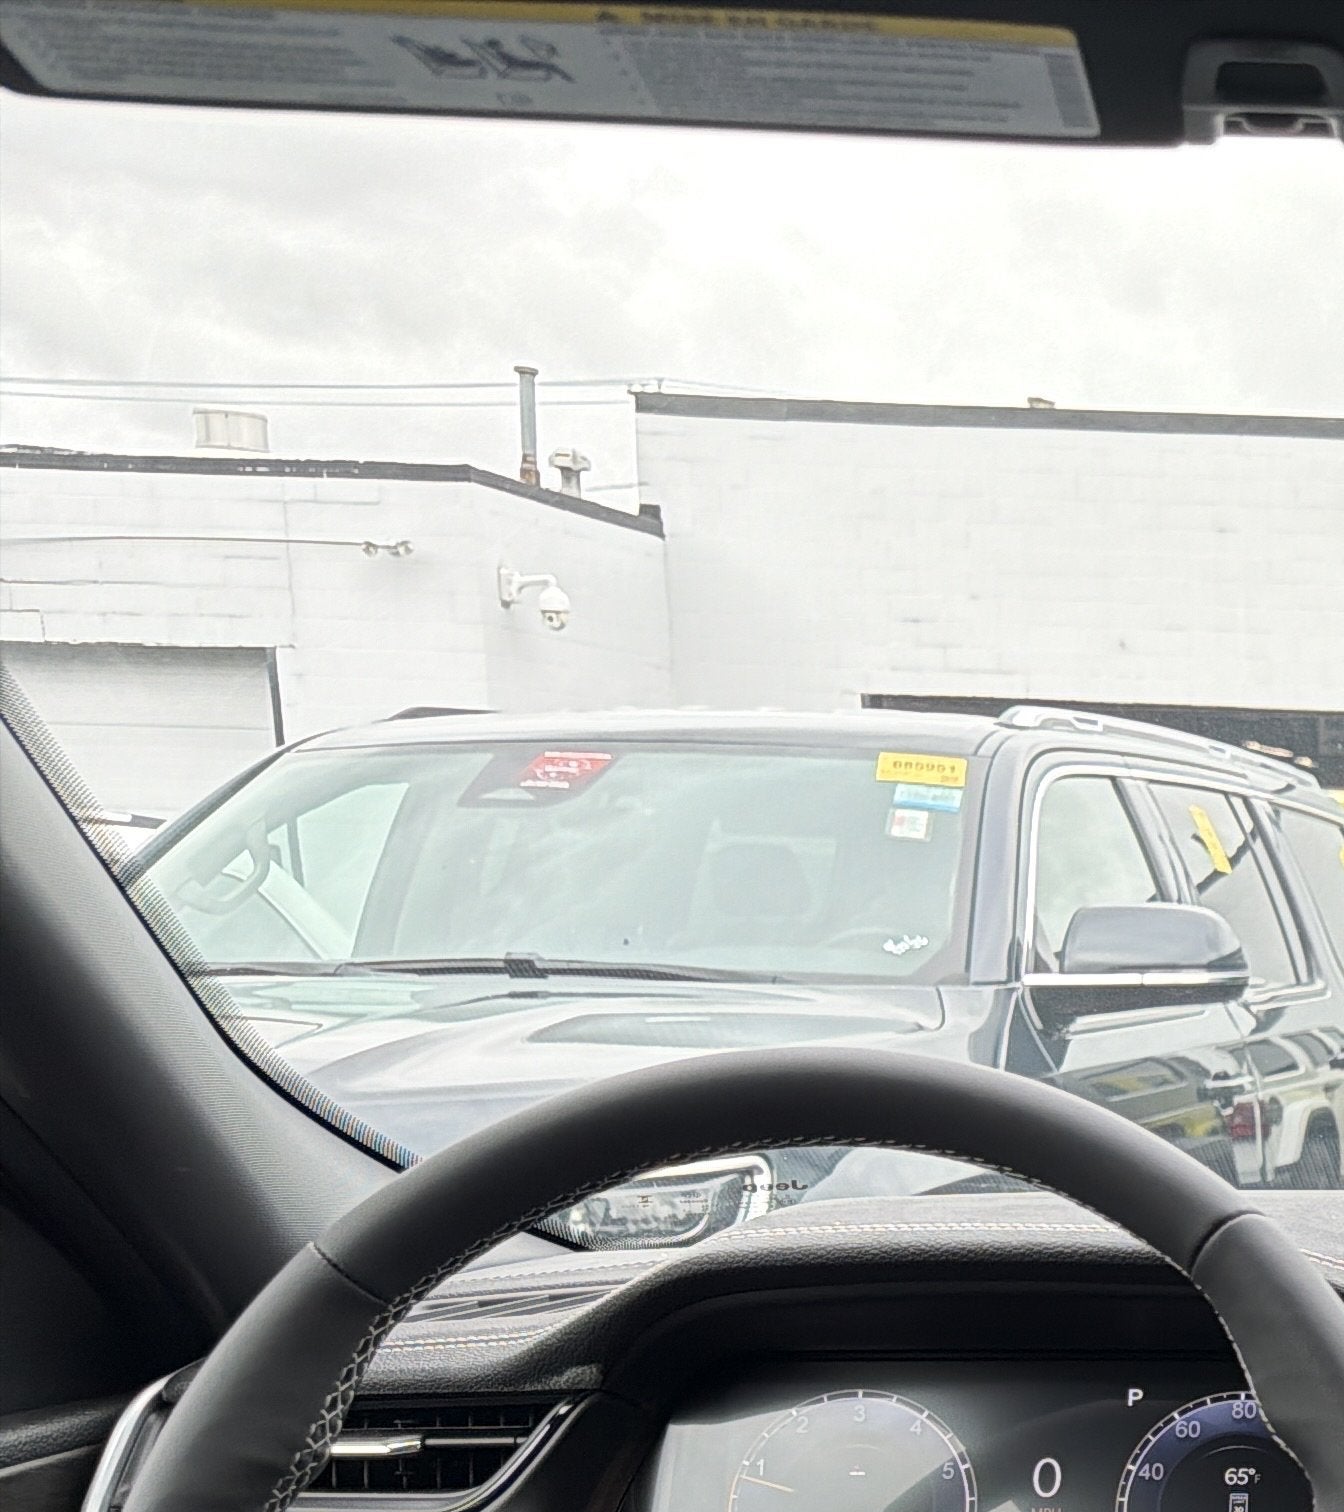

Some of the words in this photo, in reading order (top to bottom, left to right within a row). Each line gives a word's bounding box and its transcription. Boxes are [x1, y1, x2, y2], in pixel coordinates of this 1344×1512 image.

[1127, 1388, 1144, 1407] P
[853, 1405, 866, 1422] 3
[1231, 1401, 1257, 1419] 80
[796, 1416, 809, 1433] 2
[910, 1420, 922, 1436] 4
[1175, 1420, 1200, 1438] 60
[756, 1458, 764, 1476] 1
[942, 1462, 955, 1479] 5
[1138, 1463, 1164, 1480] 40
[1033, 1457, 1061, 1498] 0
